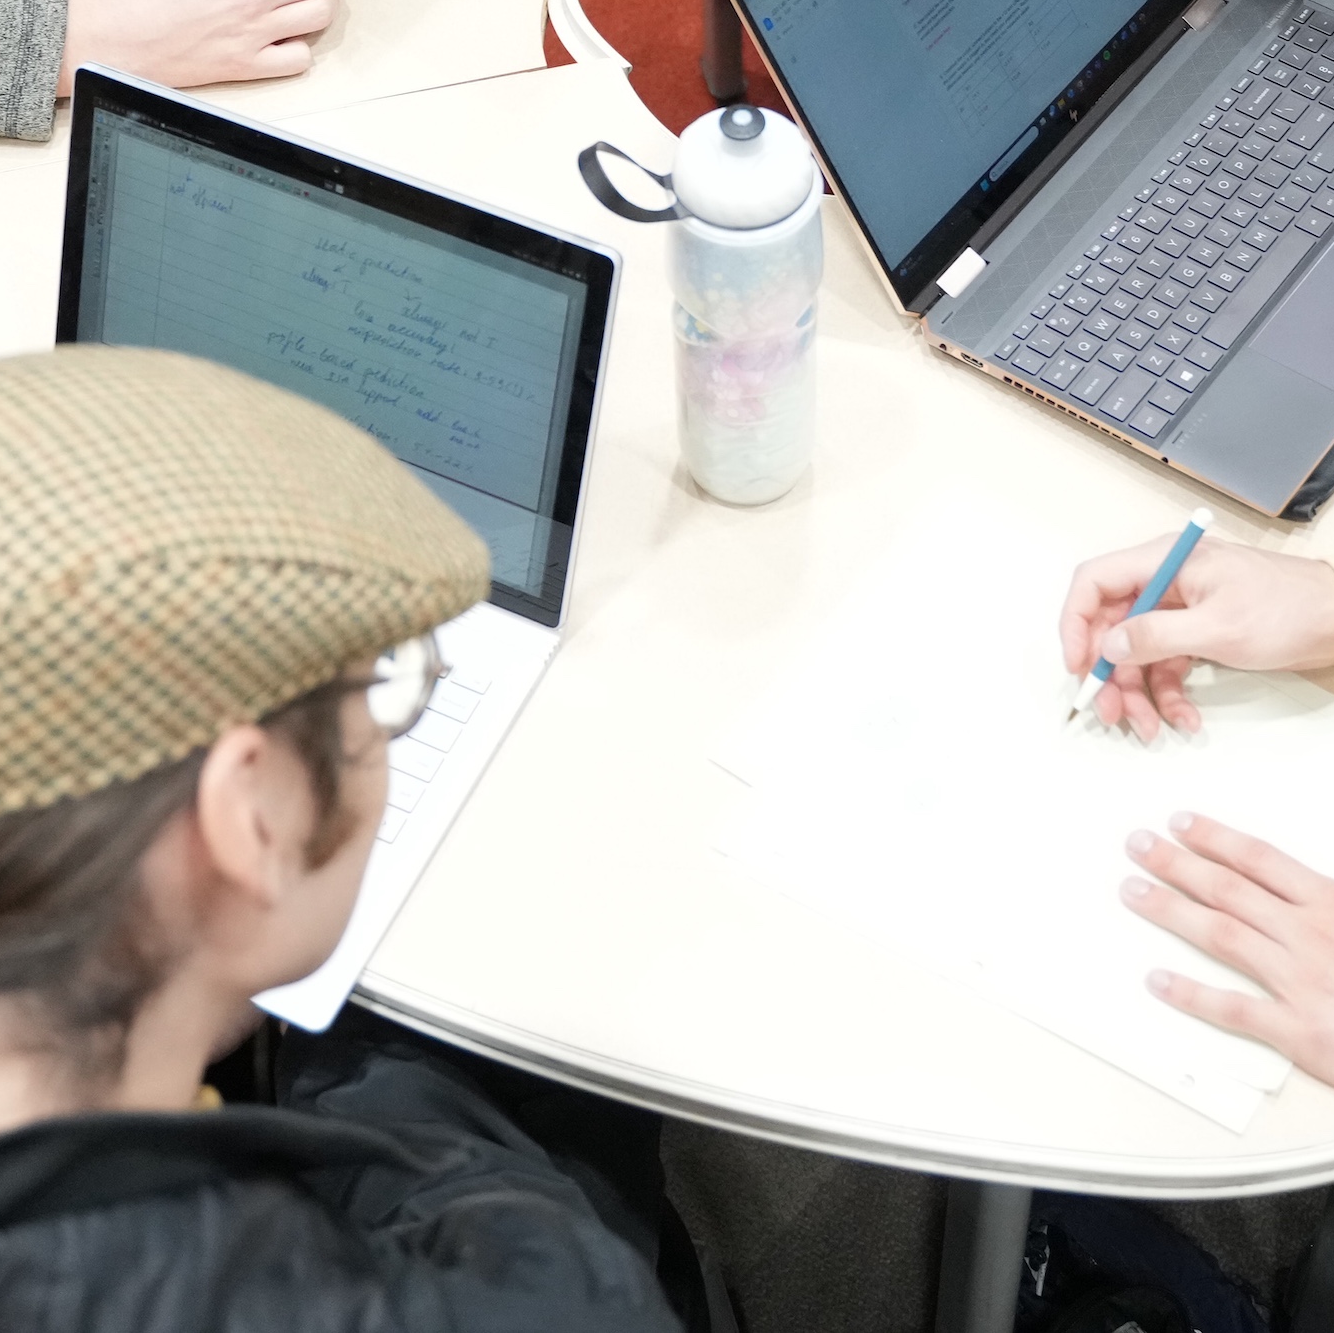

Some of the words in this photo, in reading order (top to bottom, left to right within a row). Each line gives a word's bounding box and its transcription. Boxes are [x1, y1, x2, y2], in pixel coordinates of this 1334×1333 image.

[1059, 317, 1070, 325] 2
[1077, 296, 1088, 304] 3
[1115, 255, 1124, 263] 5
[1165, 196, 1176, 204] 8
[1182, 177, 1192, 185] 9
[1078, 341, 1091, 351] Q
[1094, 318, 1109, 330] W
[1114, 299, 1127, 309] E
[1131, 279, 1144, 289] R
[1149, 259, 1160, 267] T
[1166, 238, 1178, 246] Y
[1183, 219, 1196, 228] U
[1234, 161, 1244, 170] P
[1112, 353, 1124, 362] A
[1129, 330, 1142, 340] S
[1146, 309, 1159, 319] D
[1165, 288, 1175, 298] F
[1183, 268, 1195, 277] G
[1200, 247, 1212, 257] H
[1219, 228, 1229, 237] J
[1233, 208, 1246, 218] K
[1149, 355, 1163, 366] Z
[1167, 334, 1180, 345] X
[1185, 313, 1198, 323] C
[1202, 292, 1214, 301] V
[1219, 273, 1233, 282] B
[1236, 252, 1250, 262] N
[1253, 231, 1267, 242] M
